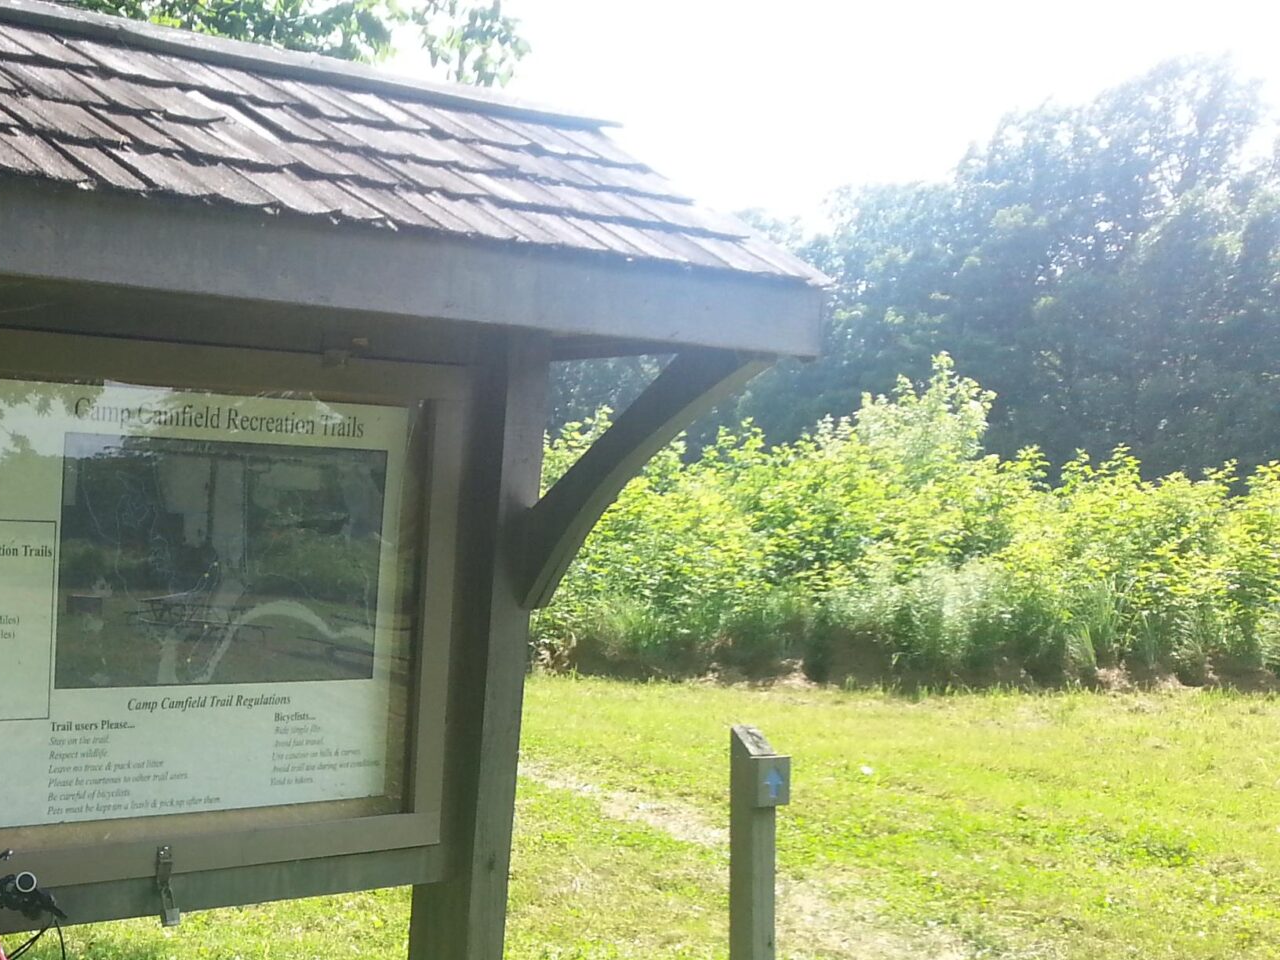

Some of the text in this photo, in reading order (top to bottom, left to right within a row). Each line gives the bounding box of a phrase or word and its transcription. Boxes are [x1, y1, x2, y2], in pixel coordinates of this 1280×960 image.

[74, 397, 131, 429] Camp
[226, 407, 315, 435] Recreation
[320, 414, 365, 438] Trails
[22, 545, 53, 558] Trails
[127, 693, 291, 713] Camp Camfield Trail Regulations
[50, 721, 73, 732] Trail
[74, 722, 98, 731] users
